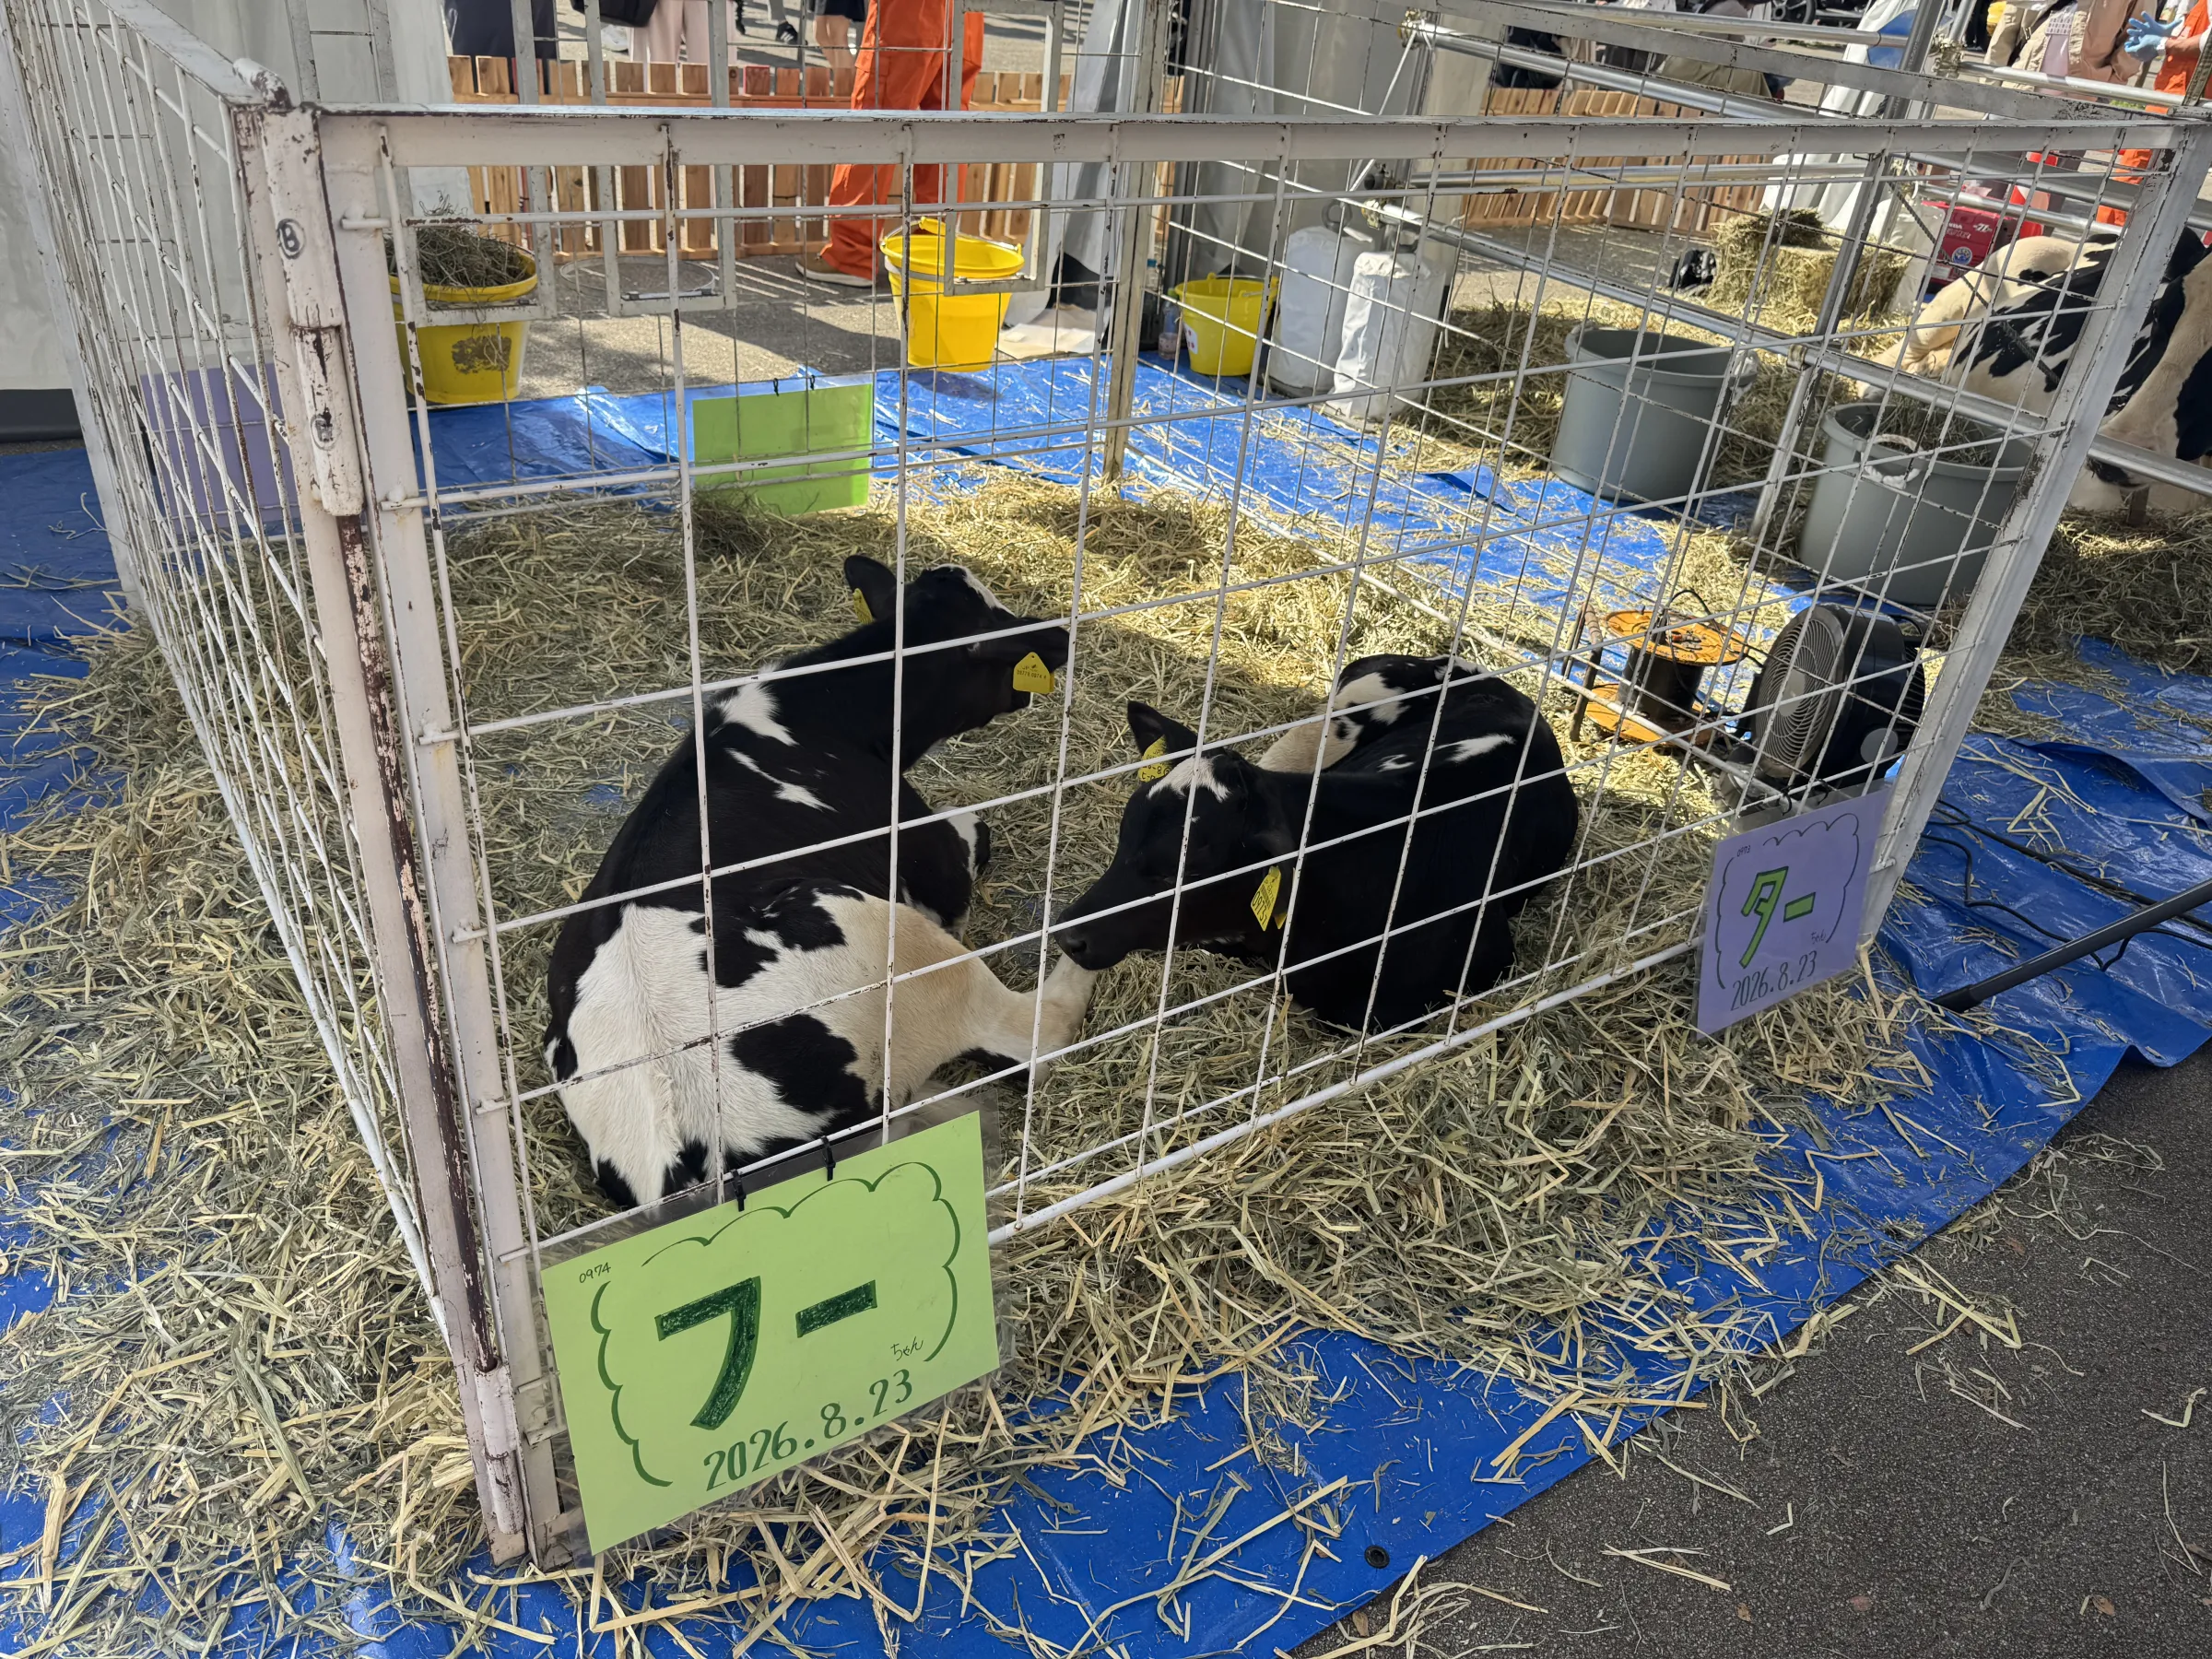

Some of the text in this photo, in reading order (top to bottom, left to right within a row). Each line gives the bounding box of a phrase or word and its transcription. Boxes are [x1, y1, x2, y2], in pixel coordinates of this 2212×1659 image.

[1739, 865, 1816, 969] ター
[1730, 950, 1818, 1011] 2026.8.23
[578, 1262, 612, 1284] 0974
[654, 1275, 877, 1430] フー
[890, 1336, 924, 1361] ちゃん
[703, 1369, 914, 1492] 2026.8.23
